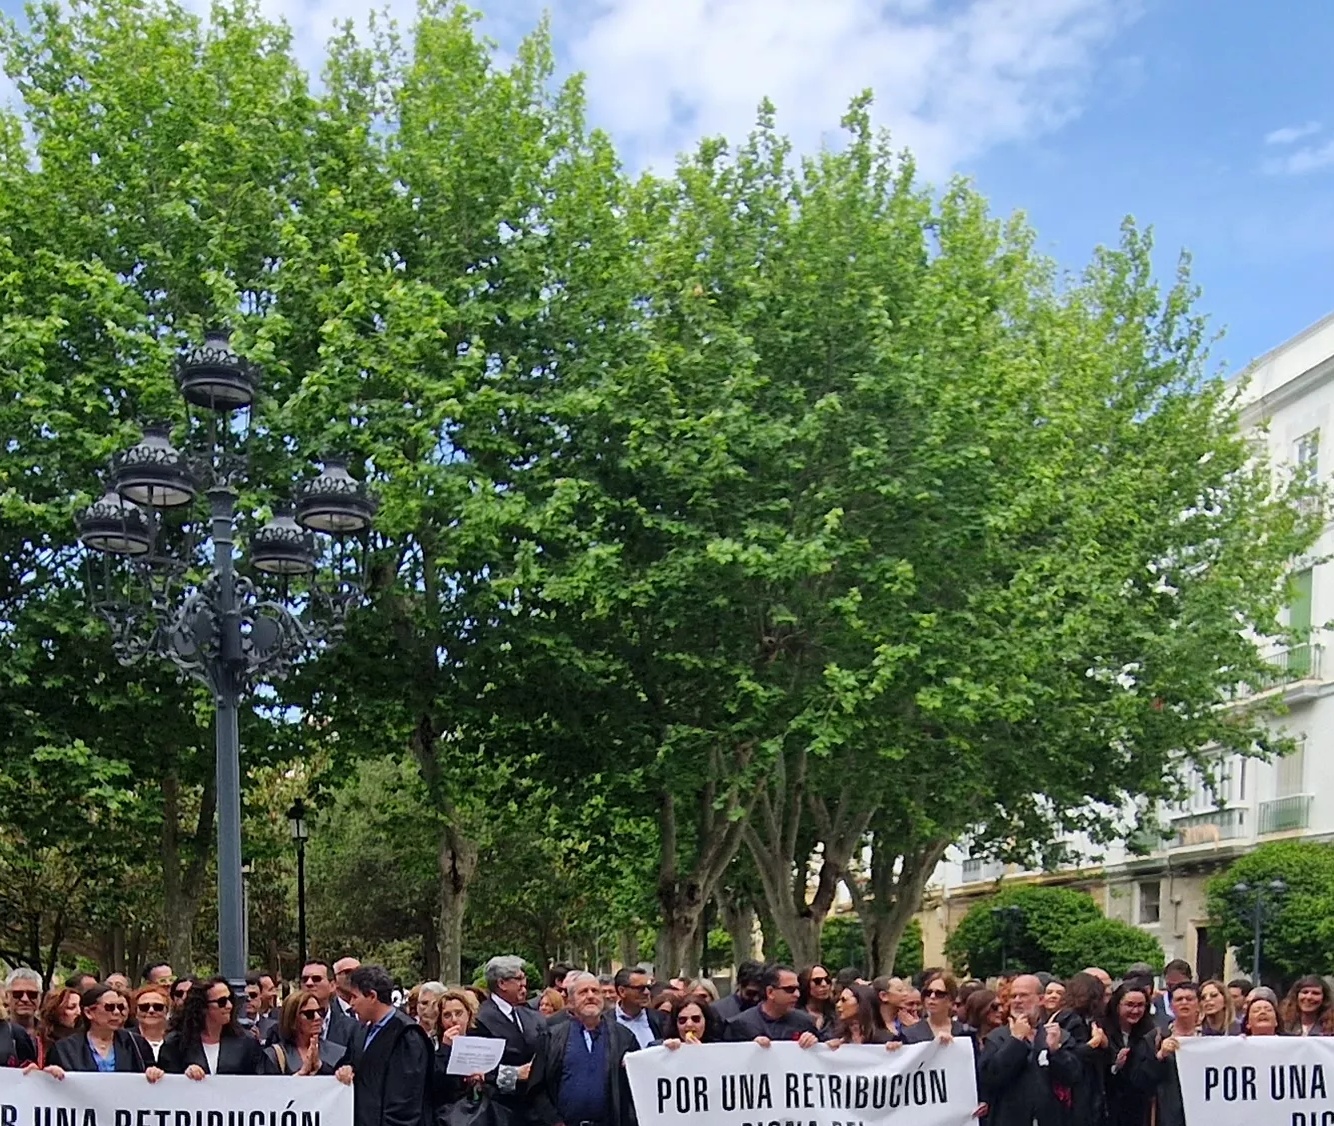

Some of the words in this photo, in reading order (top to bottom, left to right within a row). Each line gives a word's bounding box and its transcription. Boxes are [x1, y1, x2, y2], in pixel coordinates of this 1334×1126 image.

[658, 1077, 708, 1113] POR
[722, 1074, 772, 1111] UNA
[786, 1062, 947, 1109] RETRIBUCIÓN
[1206, 1066, 1256, 1101] POR
[1271, 1065, 1326, 1100] UNA
